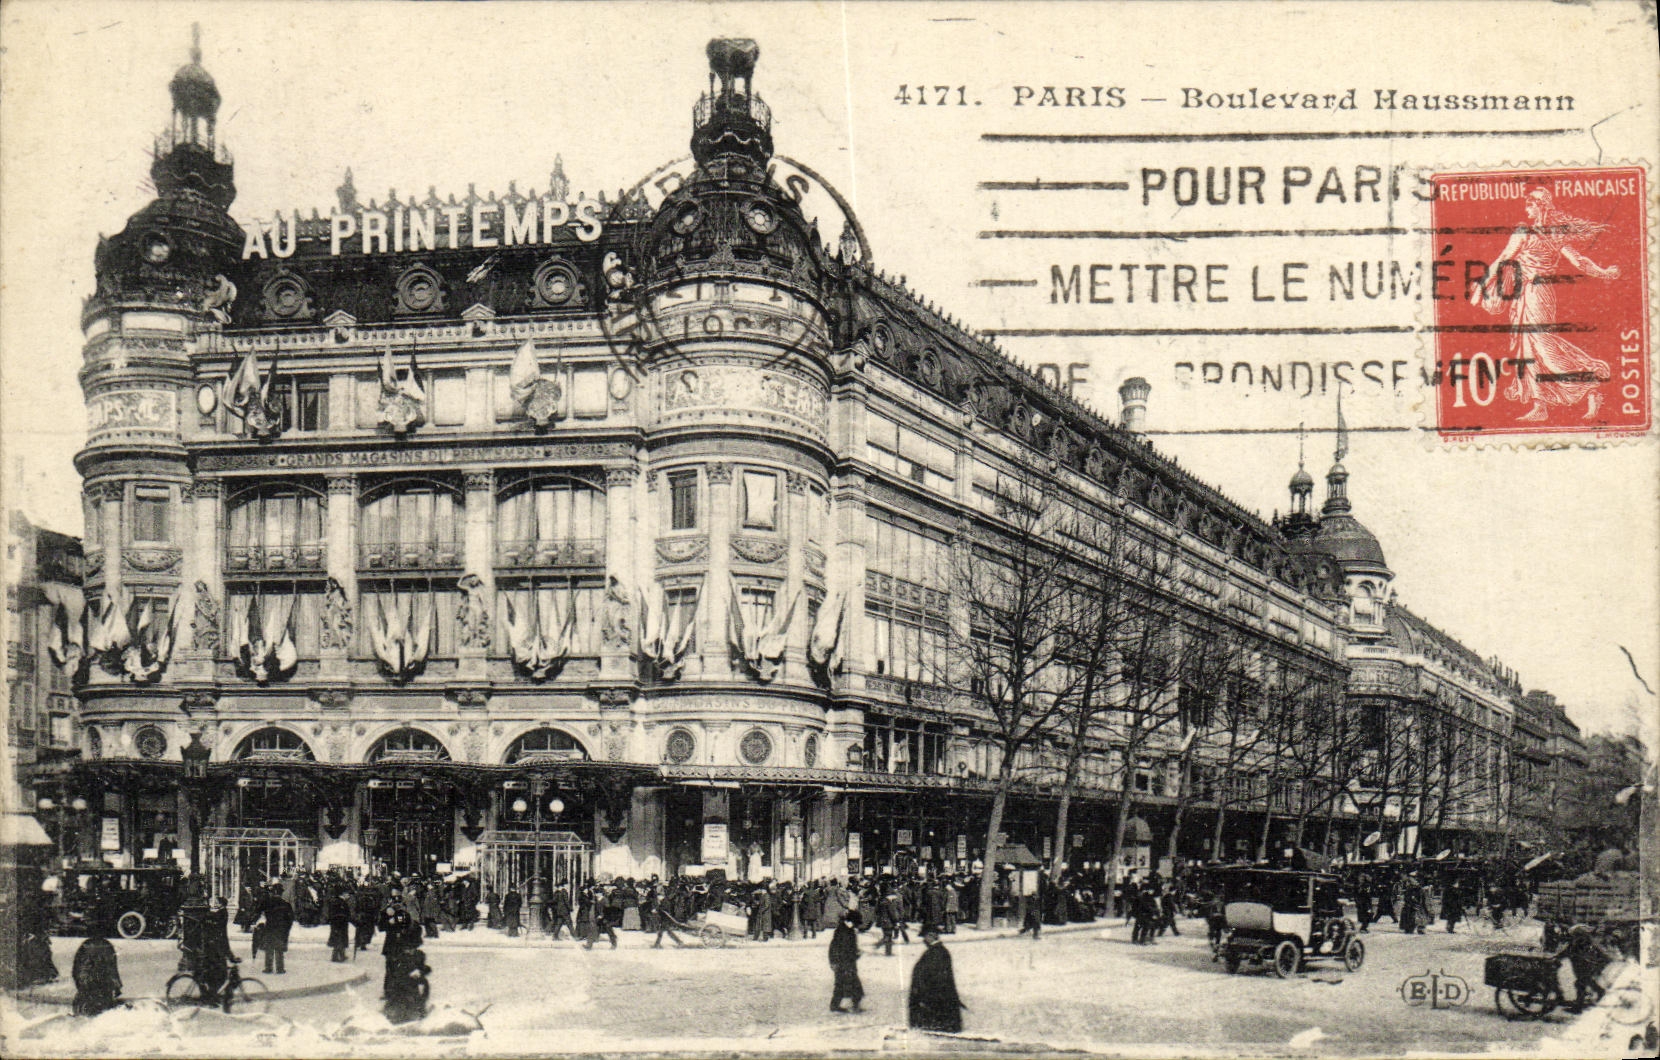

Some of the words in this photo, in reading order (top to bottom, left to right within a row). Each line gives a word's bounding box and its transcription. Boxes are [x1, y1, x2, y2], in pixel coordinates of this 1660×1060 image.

[242, 213, 297, 260] AU
[331, 199, 603, 256] PRINTEMPS
[1620, 328, 1641, 415] POSTES
